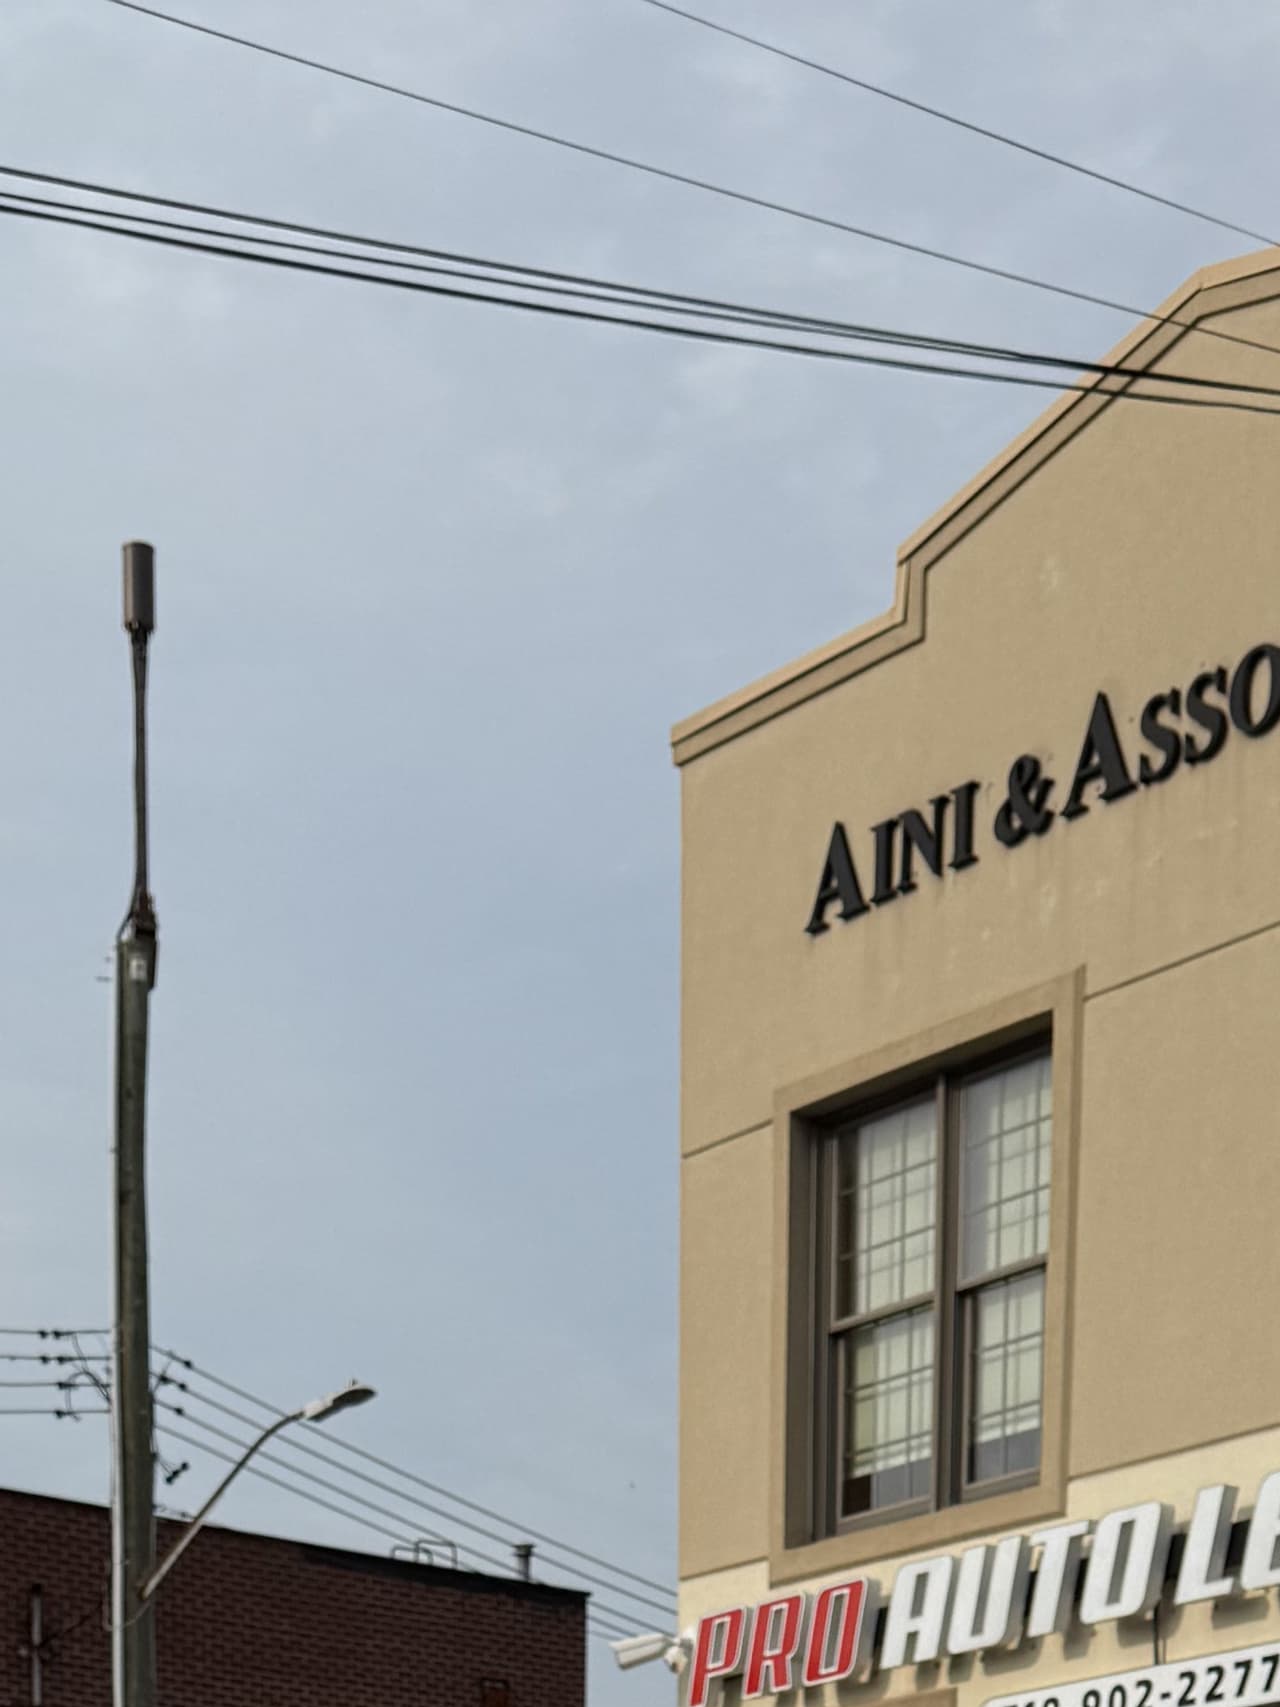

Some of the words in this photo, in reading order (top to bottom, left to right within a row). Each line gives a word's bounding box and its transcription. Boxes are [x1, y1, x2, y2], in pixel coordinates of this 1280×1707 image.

[804, 779, 980, 937] AINI
[993, 752, 1054, 849] &
[878, 1501, 1175, 1671] AUTO
